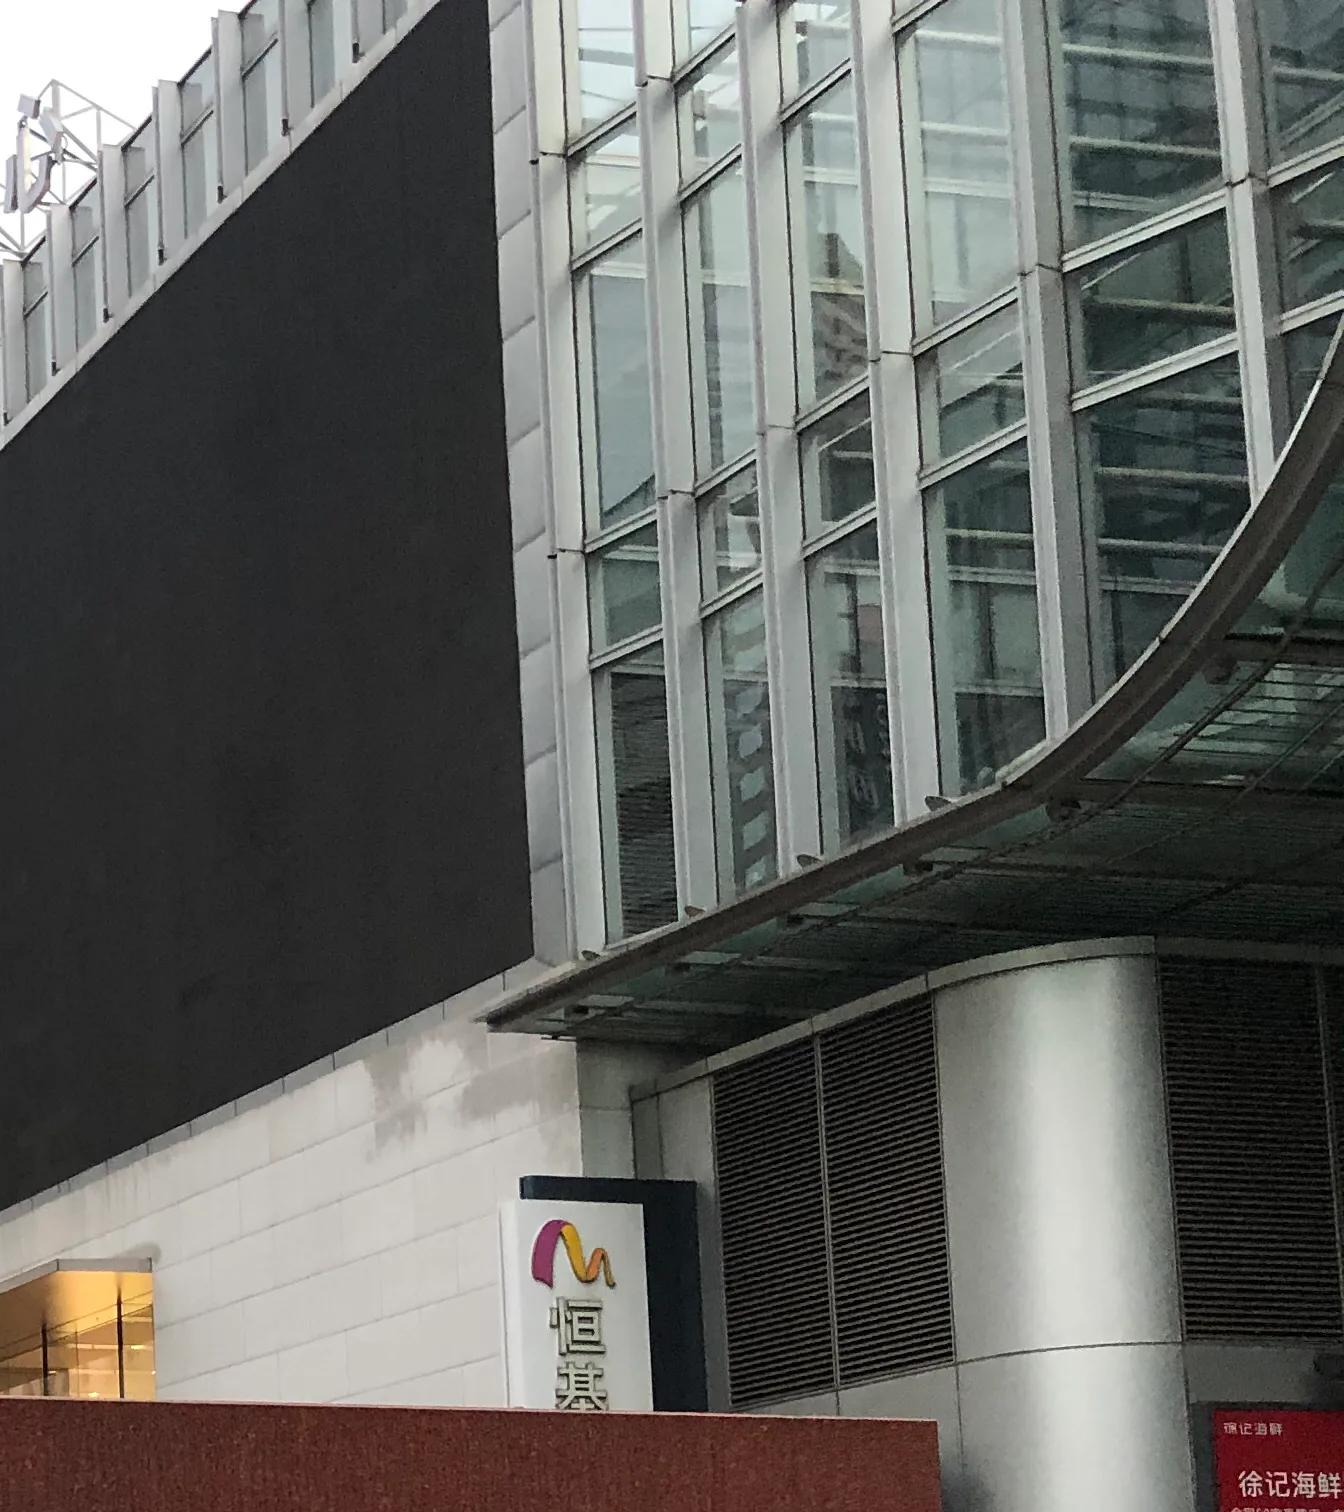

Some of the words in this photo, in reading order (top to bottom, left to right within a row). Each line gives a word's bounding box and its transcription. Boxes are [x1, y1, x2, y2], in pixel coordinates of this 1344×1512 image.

[548, 1297, 608, 1411] 恒基
[1238, 1469, 1343, 1500] 徐记海鲜
